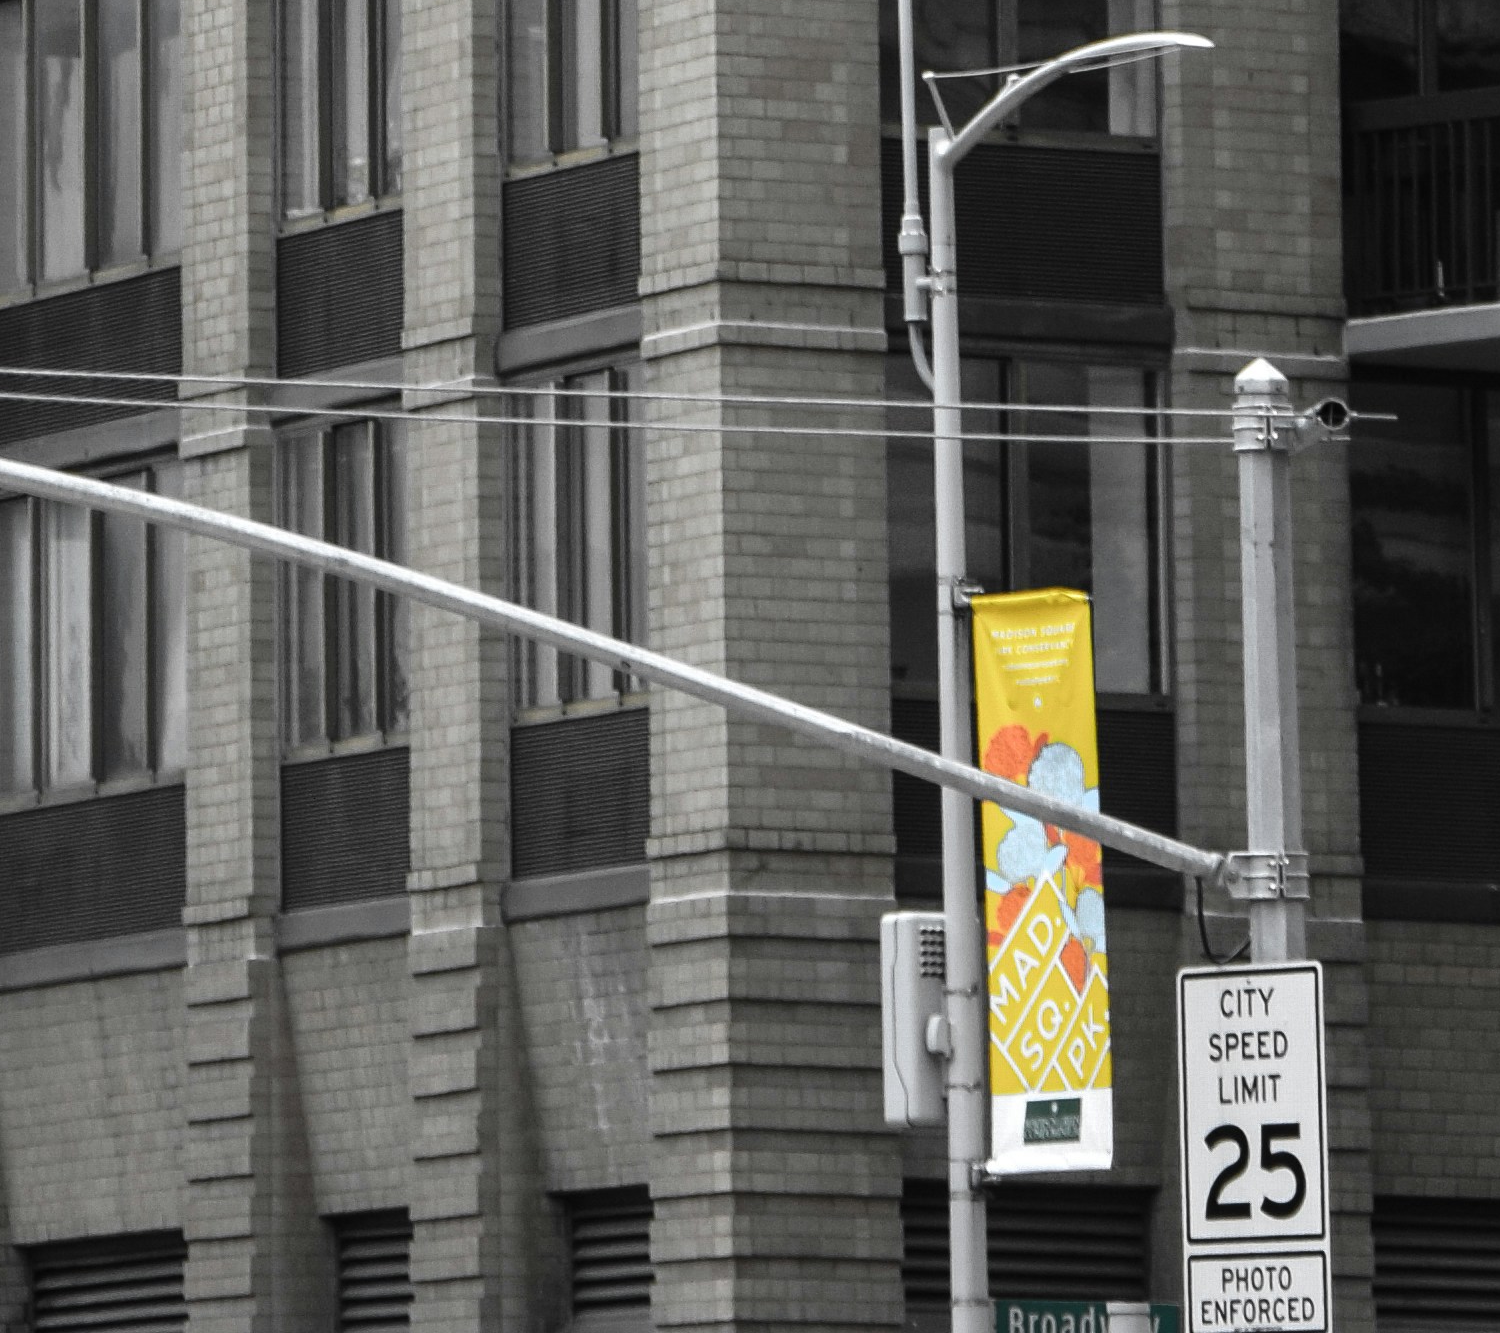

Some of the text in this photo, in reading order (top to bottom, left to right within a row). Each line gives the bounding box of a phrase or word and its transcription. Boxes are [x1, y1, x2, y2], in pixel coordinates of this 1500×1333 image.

[1220, 987, 1274, 1018] CITY
[1208, 1030, 1289, 1062] SPEED
[1218, 1074, 1282, 1105] LIMIT
[1204, 1122, 1306, 1221] 25
[1221, 1266, 1292, 1293] PHOTO
[1201, 1296, 1315, 1326] ENFORCED
